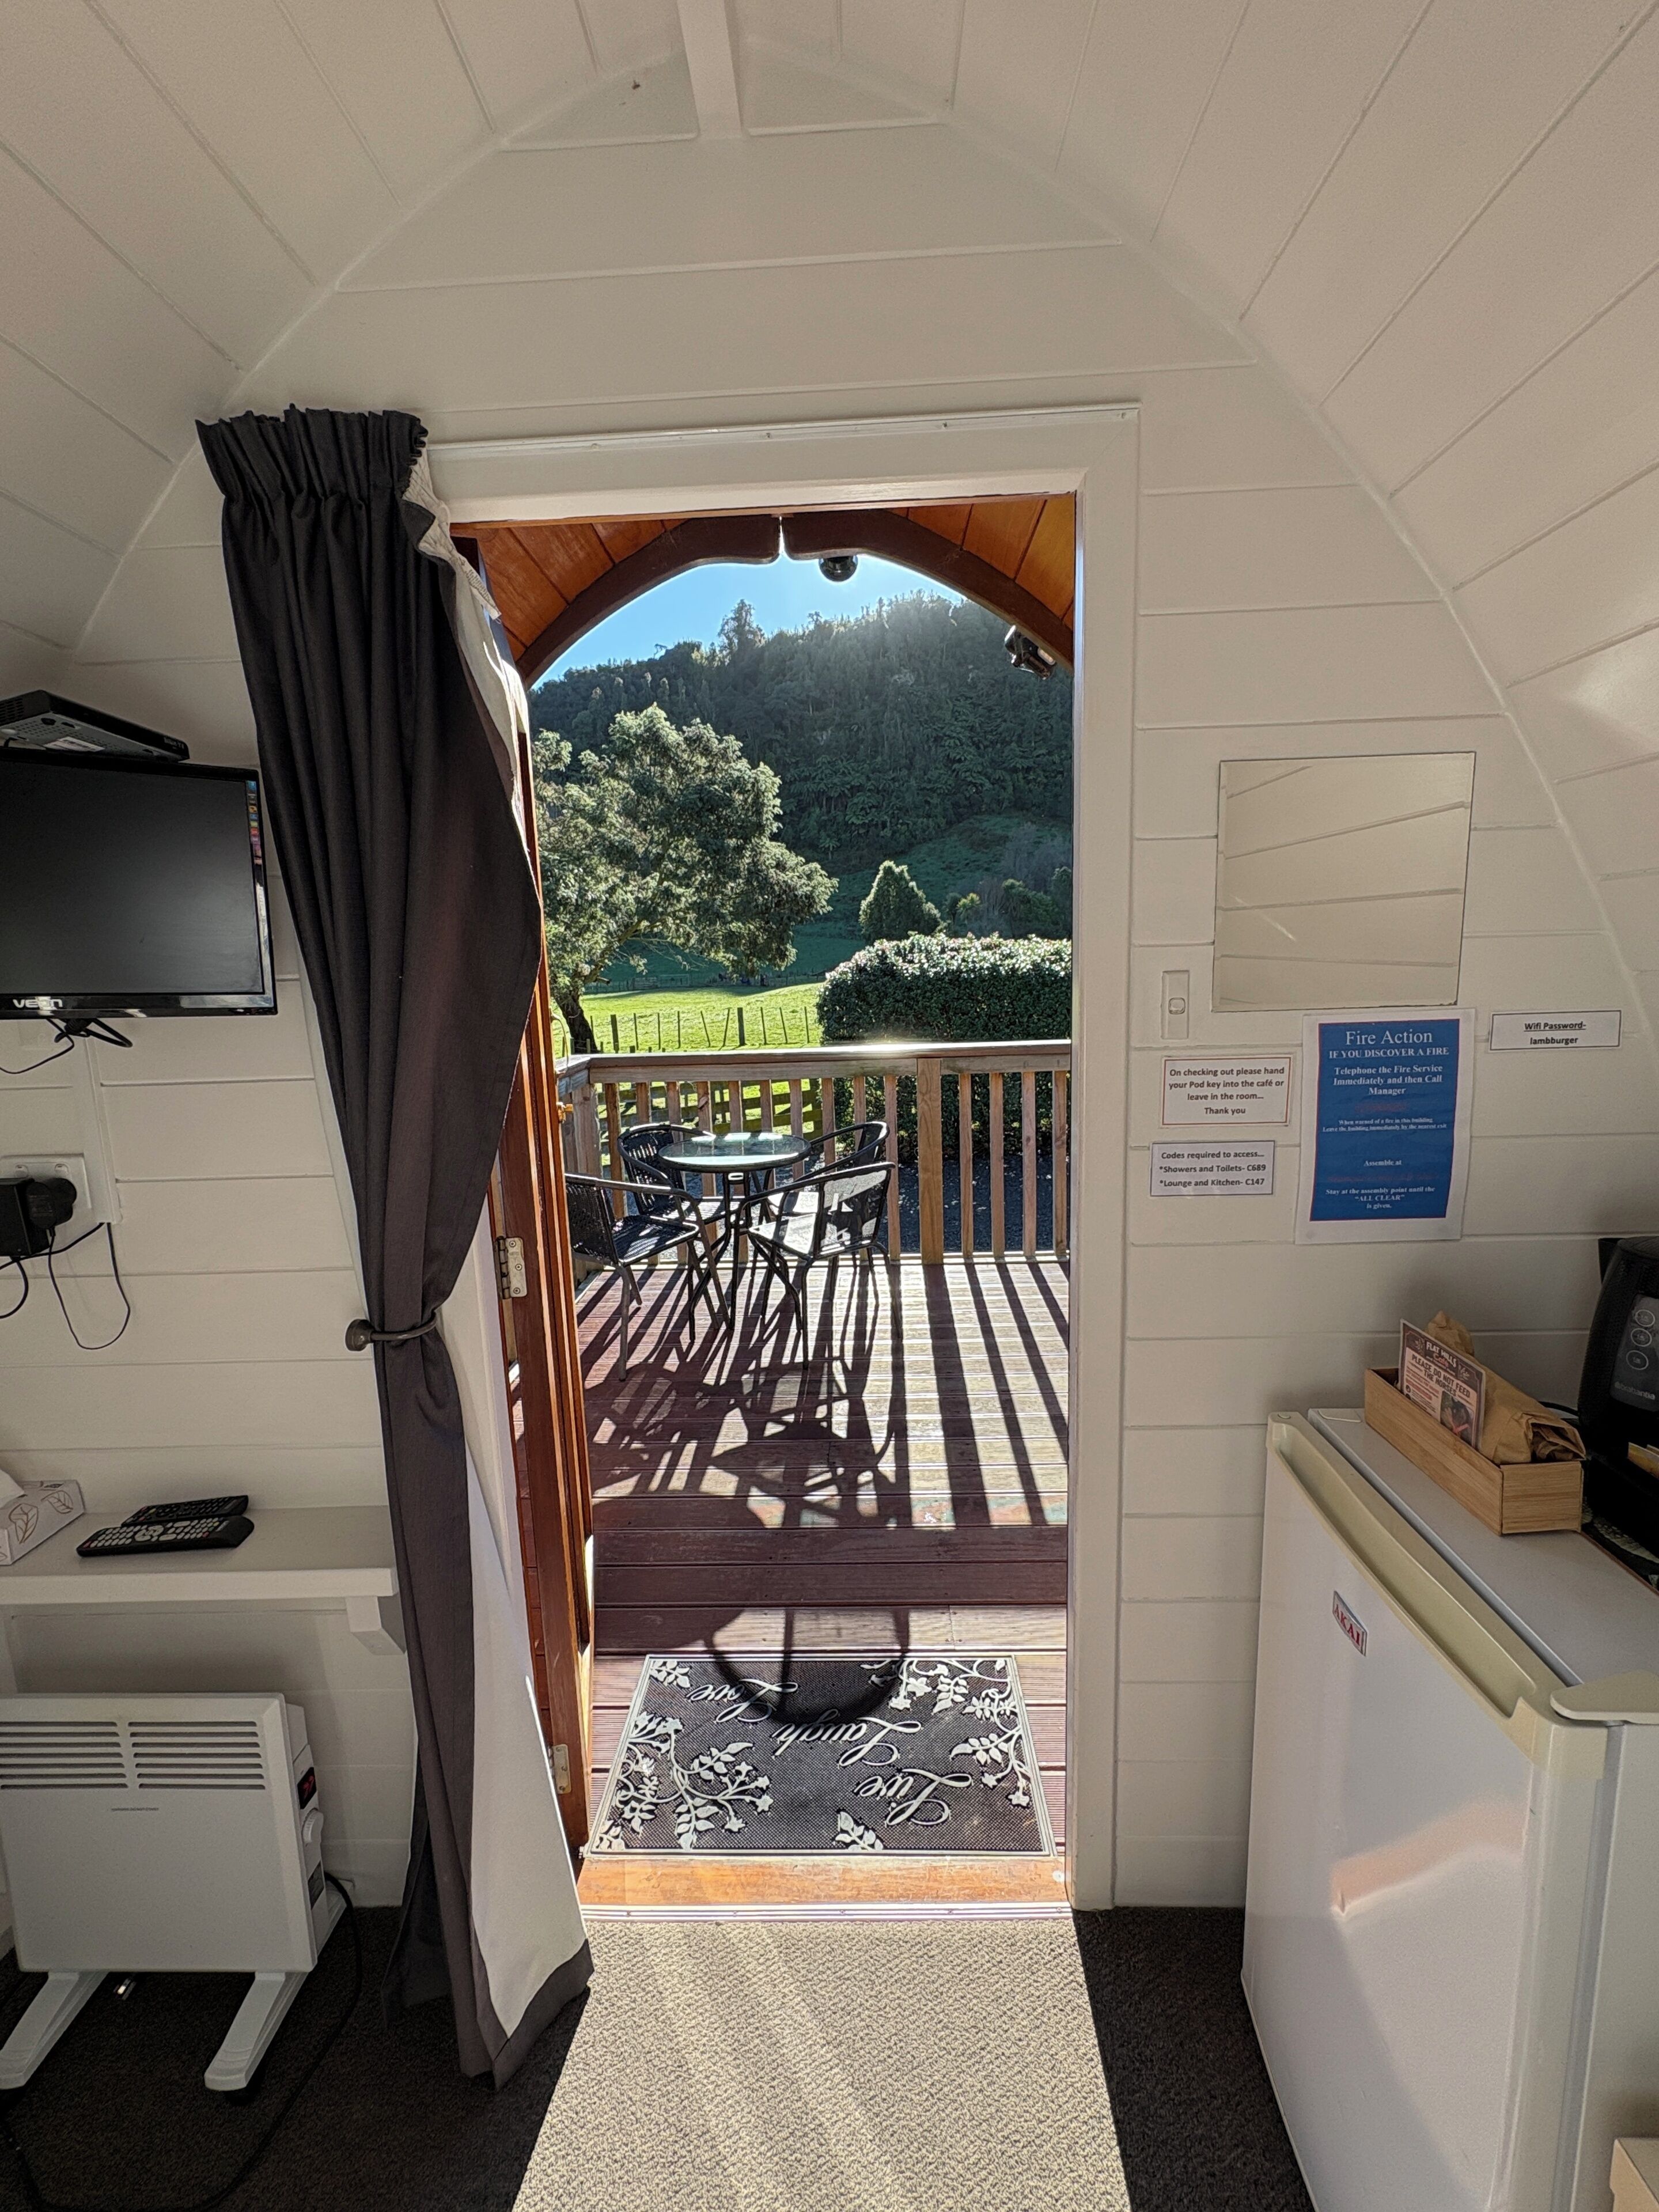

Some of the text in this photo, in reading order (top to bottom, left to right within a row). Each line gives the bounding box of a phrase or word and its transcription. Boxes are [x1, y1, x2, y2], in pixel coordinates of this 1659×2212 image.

[12, 999, 63, 1008] veon
[1524, 1021, 1586, 1031] Wifi Password-
[1346, 1029, 1433, 1045] Fire Action
[1328, 1047, 1450, 1059] IF YOU DISCOVER A FIRE
[1169, 1069, 1181, 1077] On
[1183, 1068, 1218, 1078] checking
[1236, 1067, 1262, 1077] please
[1264, 1067, 1285, 1075] hand
[1334, 1066, 1377, 1076] Telephone
[1393, 1065, 1411, 1073] Fire
[1412, 1064, 1443, 1073] Service
[1169, 1082, 1187, 1090] your
[1190, 1081, 1205, 1089] Pod
[1206, 1081, 1221, 1090] key
[1256, 1078, 1273, 1088] café
[1334, 1074, 1442, 1086] Immediately and then Call
[1187, 1093, 1209, 1101] leave
[1220, 1092, 1234, 1100] the
[1368, 1087, 1407, 1096] Manager
[1205, 1107, 1246, 1116] Thank you
[1187, 1151, 1221, 1161] required
[1199, 1165, 1214, 1173] and
[1215, 1164, 1245, 1172] Toilets-
[1247, 1164, 1266, 1172] C689
[1211, 1178, 1244, 1187] Kitchen-
[1245, 1178, 1265, 1186] C147
[1426, 1340, 1441, 1354] FLAT
[1411, 1354, 1433, 1372] PLEASE
[1433, 1368, 1442, 1378] DO
[1442, 1373, 1455, 1387] NOT
[1456, 1382, 1471, 1399] FEED
[1423, 1370, 1434, 1382] THE
[1435, 1378, 1457, 1397] HORSES
[1334, 1604, 1361, 1646] AKAI
[687, 1677, 798, 1724] Love
[771, 1707, 922, 1768] Laugh
[853, 1768, 973, 1826] Live
